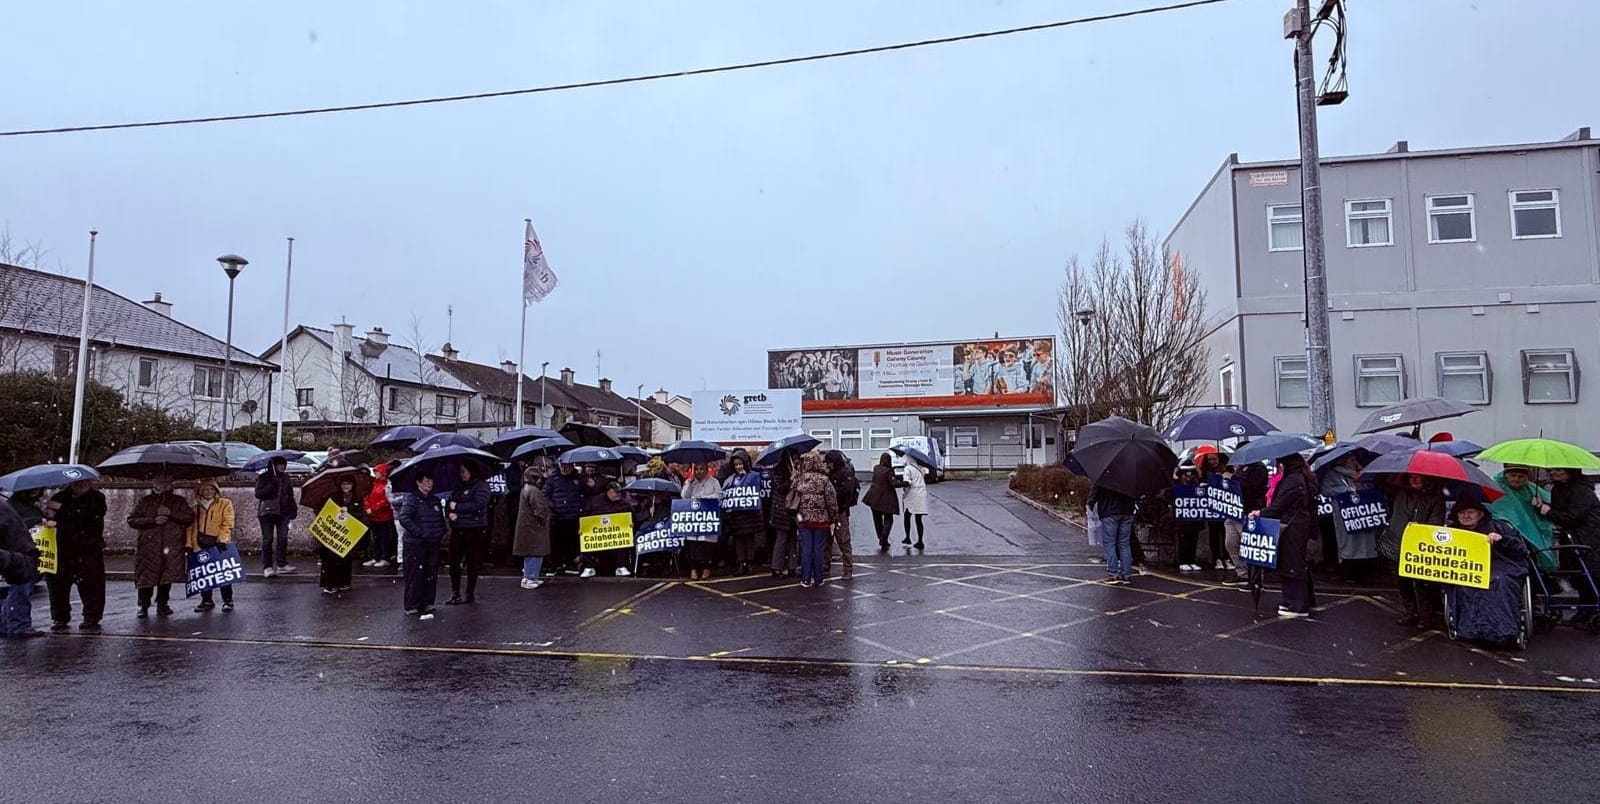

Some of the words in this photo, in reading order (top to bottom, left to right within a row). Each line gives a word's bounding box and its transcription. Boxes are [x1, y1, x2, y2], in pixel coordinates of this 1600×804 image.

[743, 393, 767, 404] gretb
[1175, 497, 1209, 508] OFFIC
[1207, 486, 1244, 507] OFFICIAL
[672, 511, 720, 521] OFFICIAL
[1208, 497, 1244, 519] PROTEST
[1340, 502, 1386, 519] OFFICIAL
[325, 515, 350, 535] Cosain
[592, 525, 621, 534] Cosain
[671, 522, 720, 533] PROTEST
[1344, 513, 1387, 532] PROTEST
[584, 539, 631, 550] Oideachais
[637, 538, 686, 553] PROTEST
[1240, 532, 1276, 549] FFICIAL
[1418, 542, 1467, 557] Cosain
[189, 557, 241, 580] FFICIAL
[1404, 552, 1483, 572] Caighdeáin
[1404, 563, 1482, 584] Oideachais
